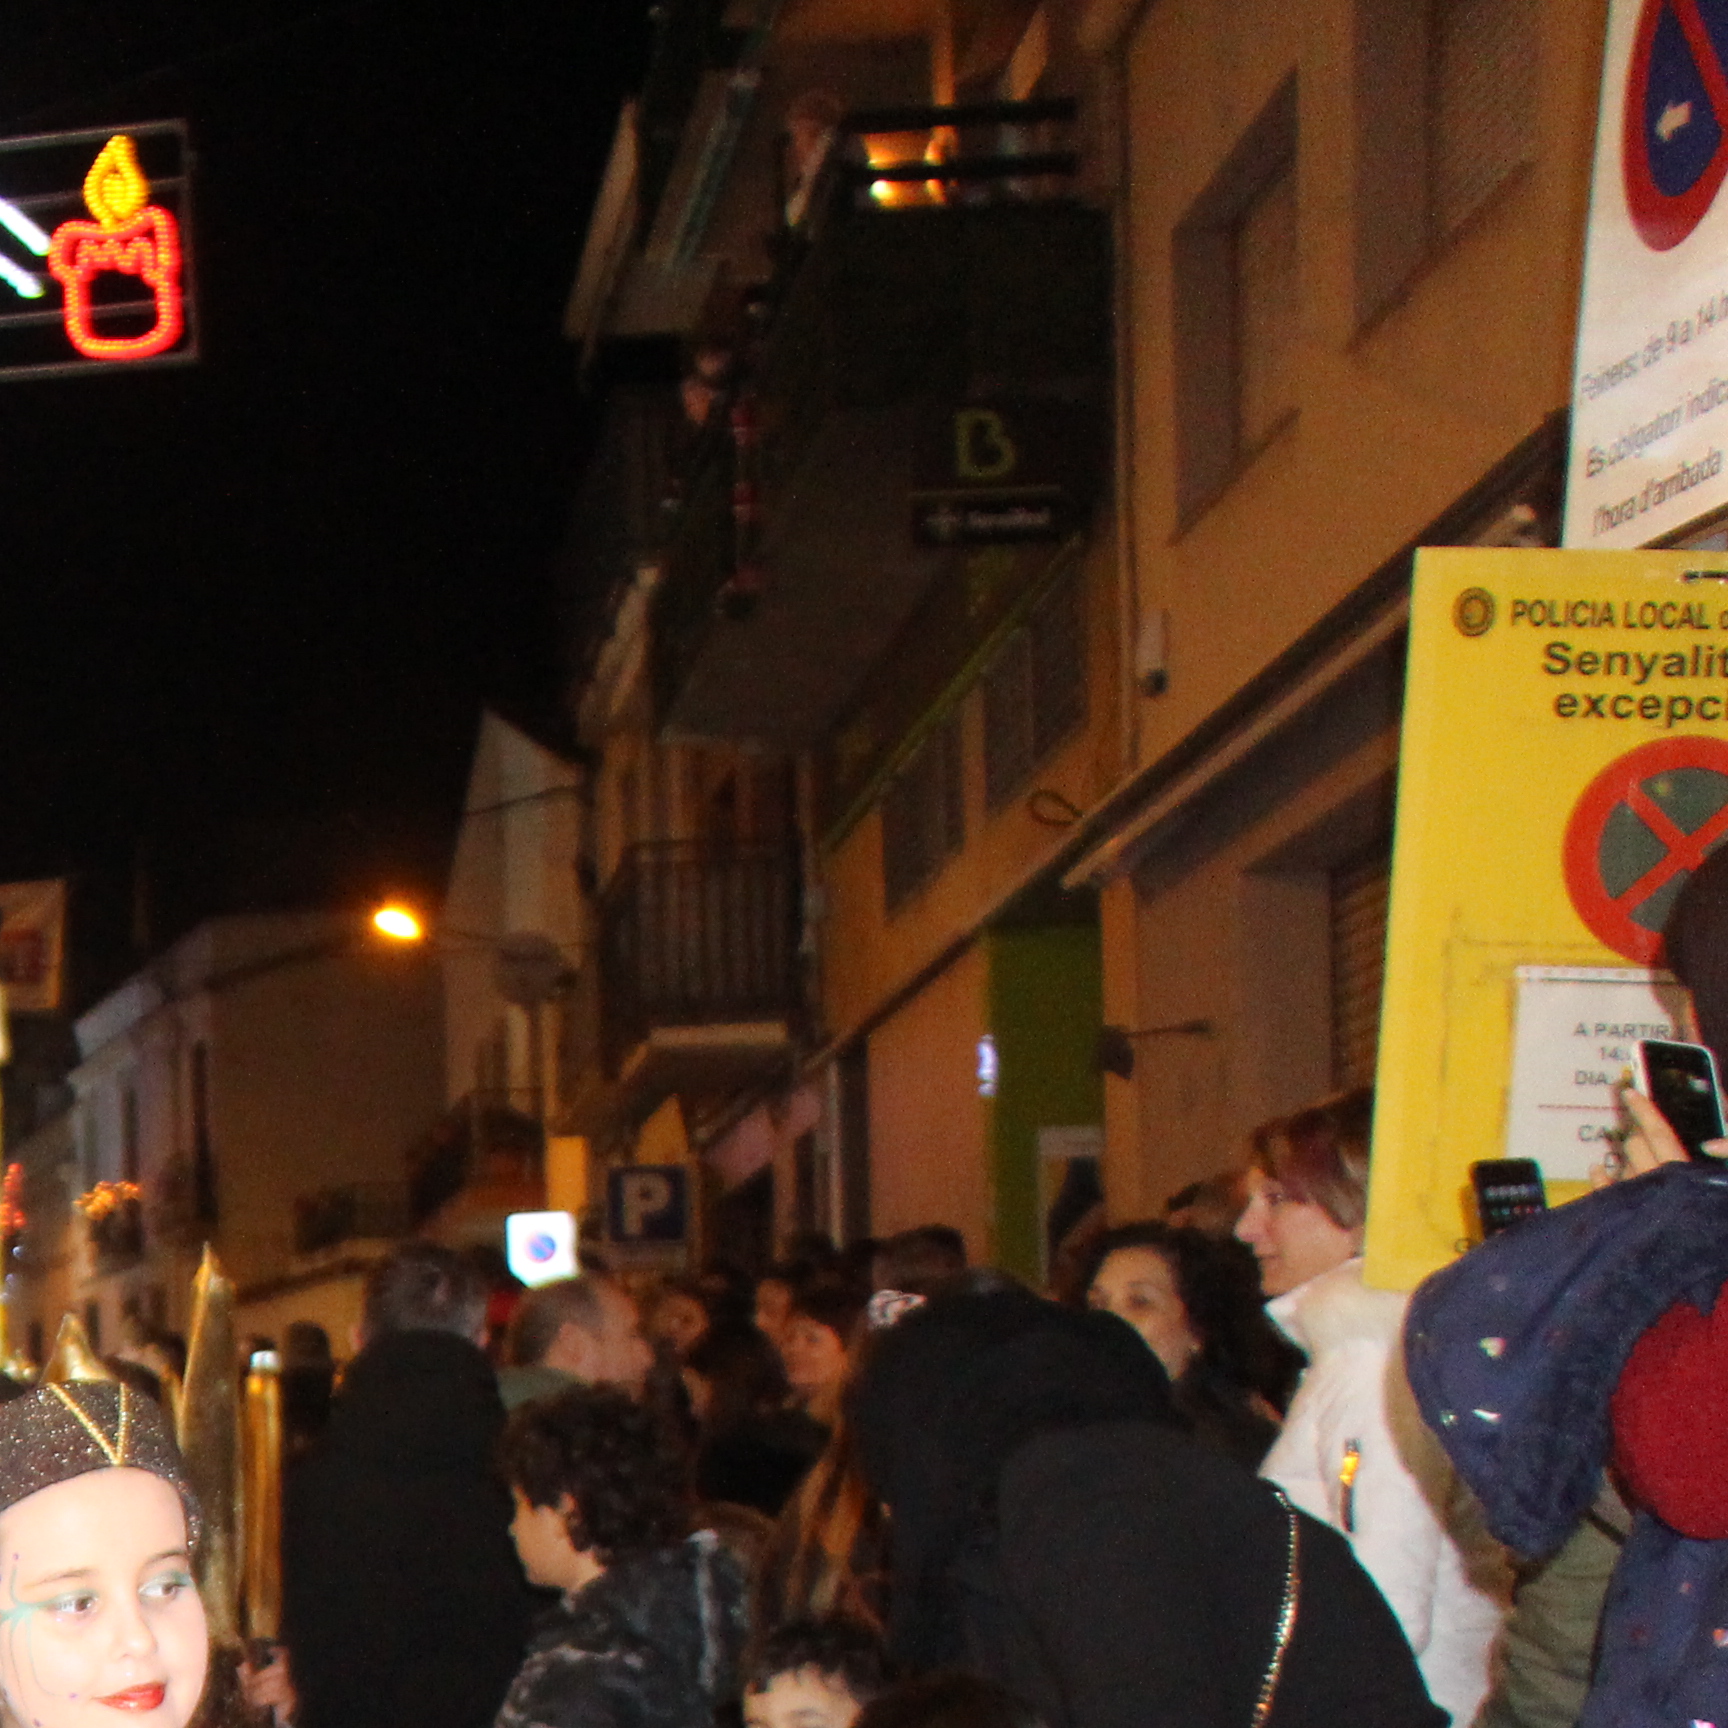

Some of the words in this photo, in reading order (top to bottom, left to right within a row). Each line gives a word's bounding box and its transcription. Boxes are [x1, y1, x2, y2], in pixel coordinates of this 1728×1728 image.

[1511, 599, 1616, 628] POLICIA
[1623, 601, 1712, 630] LOCAL
[1594, 1022, 1671, 1040] PARTIR
[623, 1172, 671, 1235] P
